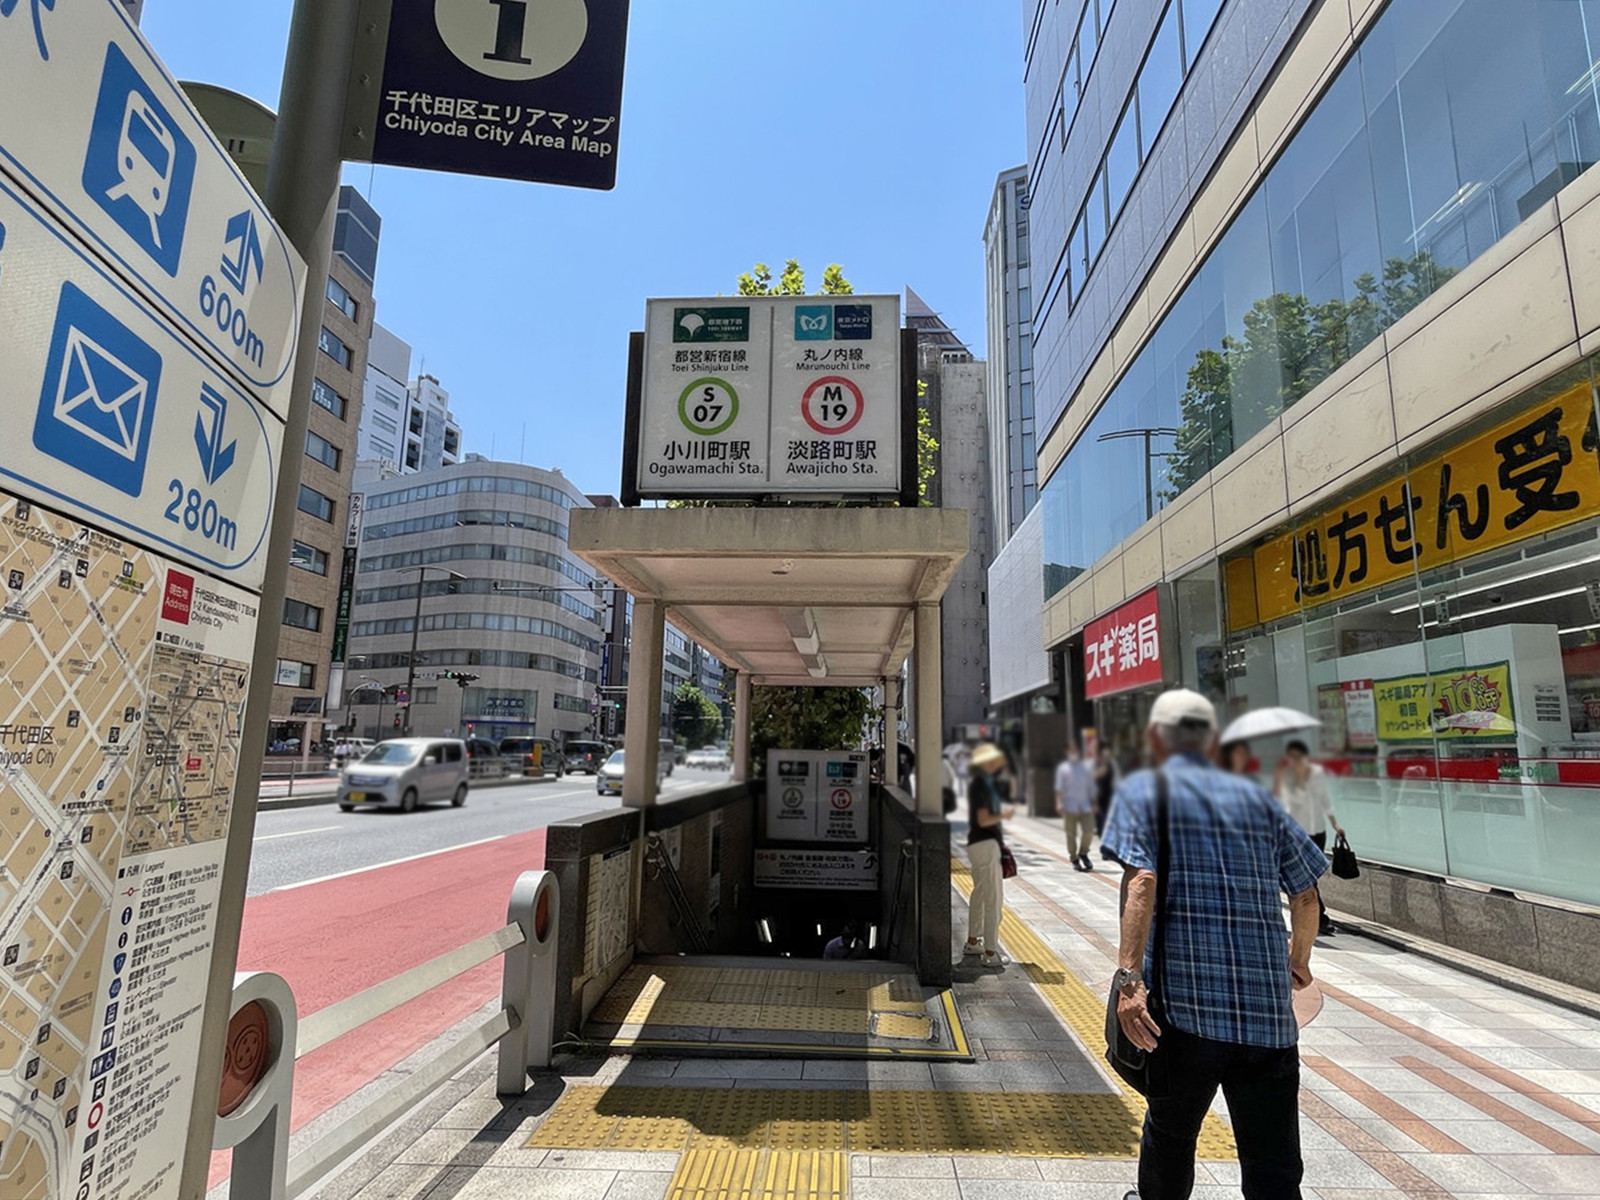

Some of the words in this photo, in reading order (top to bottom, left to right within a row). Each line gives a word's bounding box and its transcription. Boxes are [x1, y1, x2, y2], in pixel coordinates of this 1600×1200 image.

[386, 90, 616, 135] 千代田区エリアマップ
[385, 112, 468, 138] Chiyoda
[474, 123, 515, 146] City
[519, 129, 565, 149] Area
[571, 136, 612, 157] Map
[199, 274, 265, 369] 600m
[675, 349, 746, 363] 都営新宿線
[804, 348, 863, 361] 丸ノ内線
[671, 363, 689, 372] Toei
[691, 363, 729, 374] Shinjuku
[731, 363, 750, 372] Line
[796, 362, 849, 371] Marunouchi
[851, 362, 871, 370] Line
[703, 386, 715, 403] S
[823, 386, 843, 401] M
[693, 405, 724, 423] 07
[821, 404, 848, 422] 19
[663, 440, 750, 461] 小川町駅
[787, 439, 877, 461] 淡路町駅
[649, 462, 735, 477] Ogawamachi
[738, 462, 764, 475] Sta.
[786, 462, 848, 477] Awajicho
[852, 462, 878, 475] Sta.
[164, 479, 237, 551] 280m
[165, 596, 189, 613] Address
[1086, 613, 1160, 682] スギ薬局
[0, 724, 55, 745] 千代田区
[36, 747, 58, 768] City
